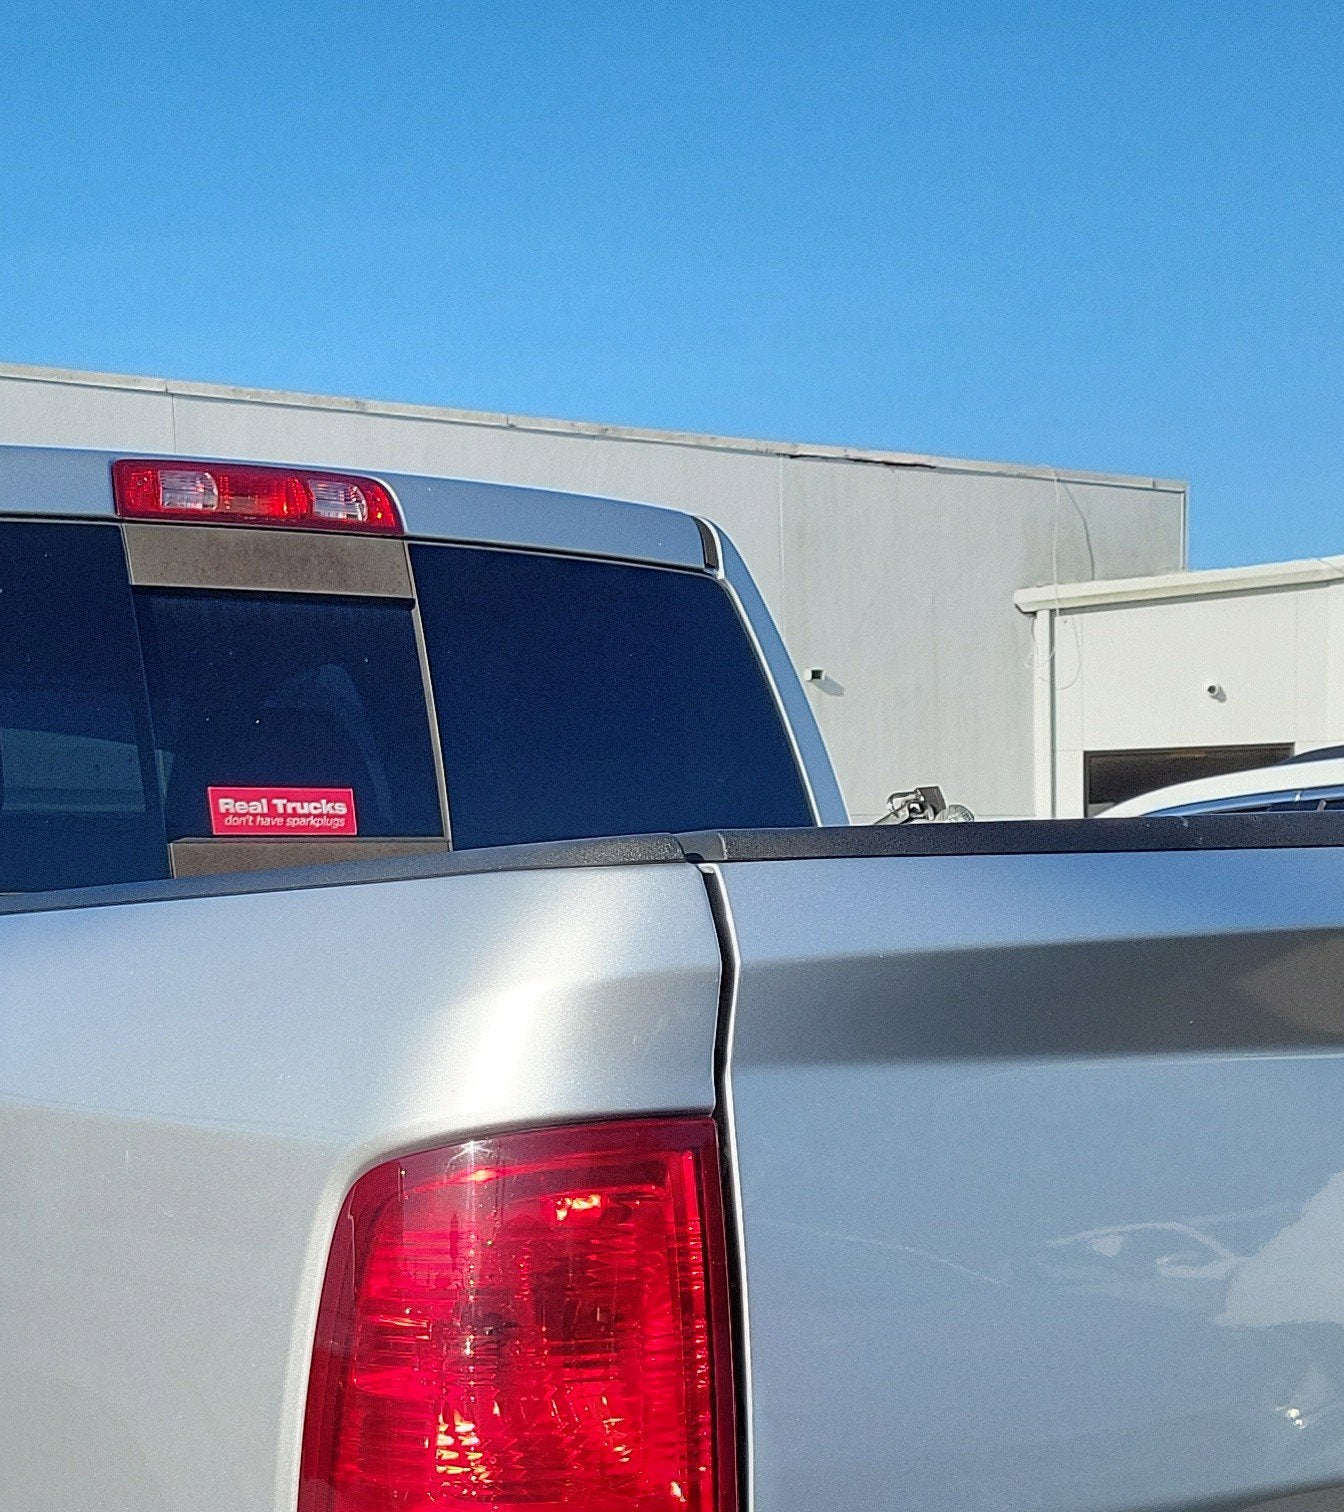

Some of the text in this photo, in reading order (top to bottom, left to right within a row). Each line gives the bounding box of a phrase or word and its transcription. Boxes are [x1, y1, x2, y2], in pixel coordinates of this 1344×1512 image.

[218, 798, 348, 815] Real Trucks
[224, 815, 346, 829] don't have sparkplugs
